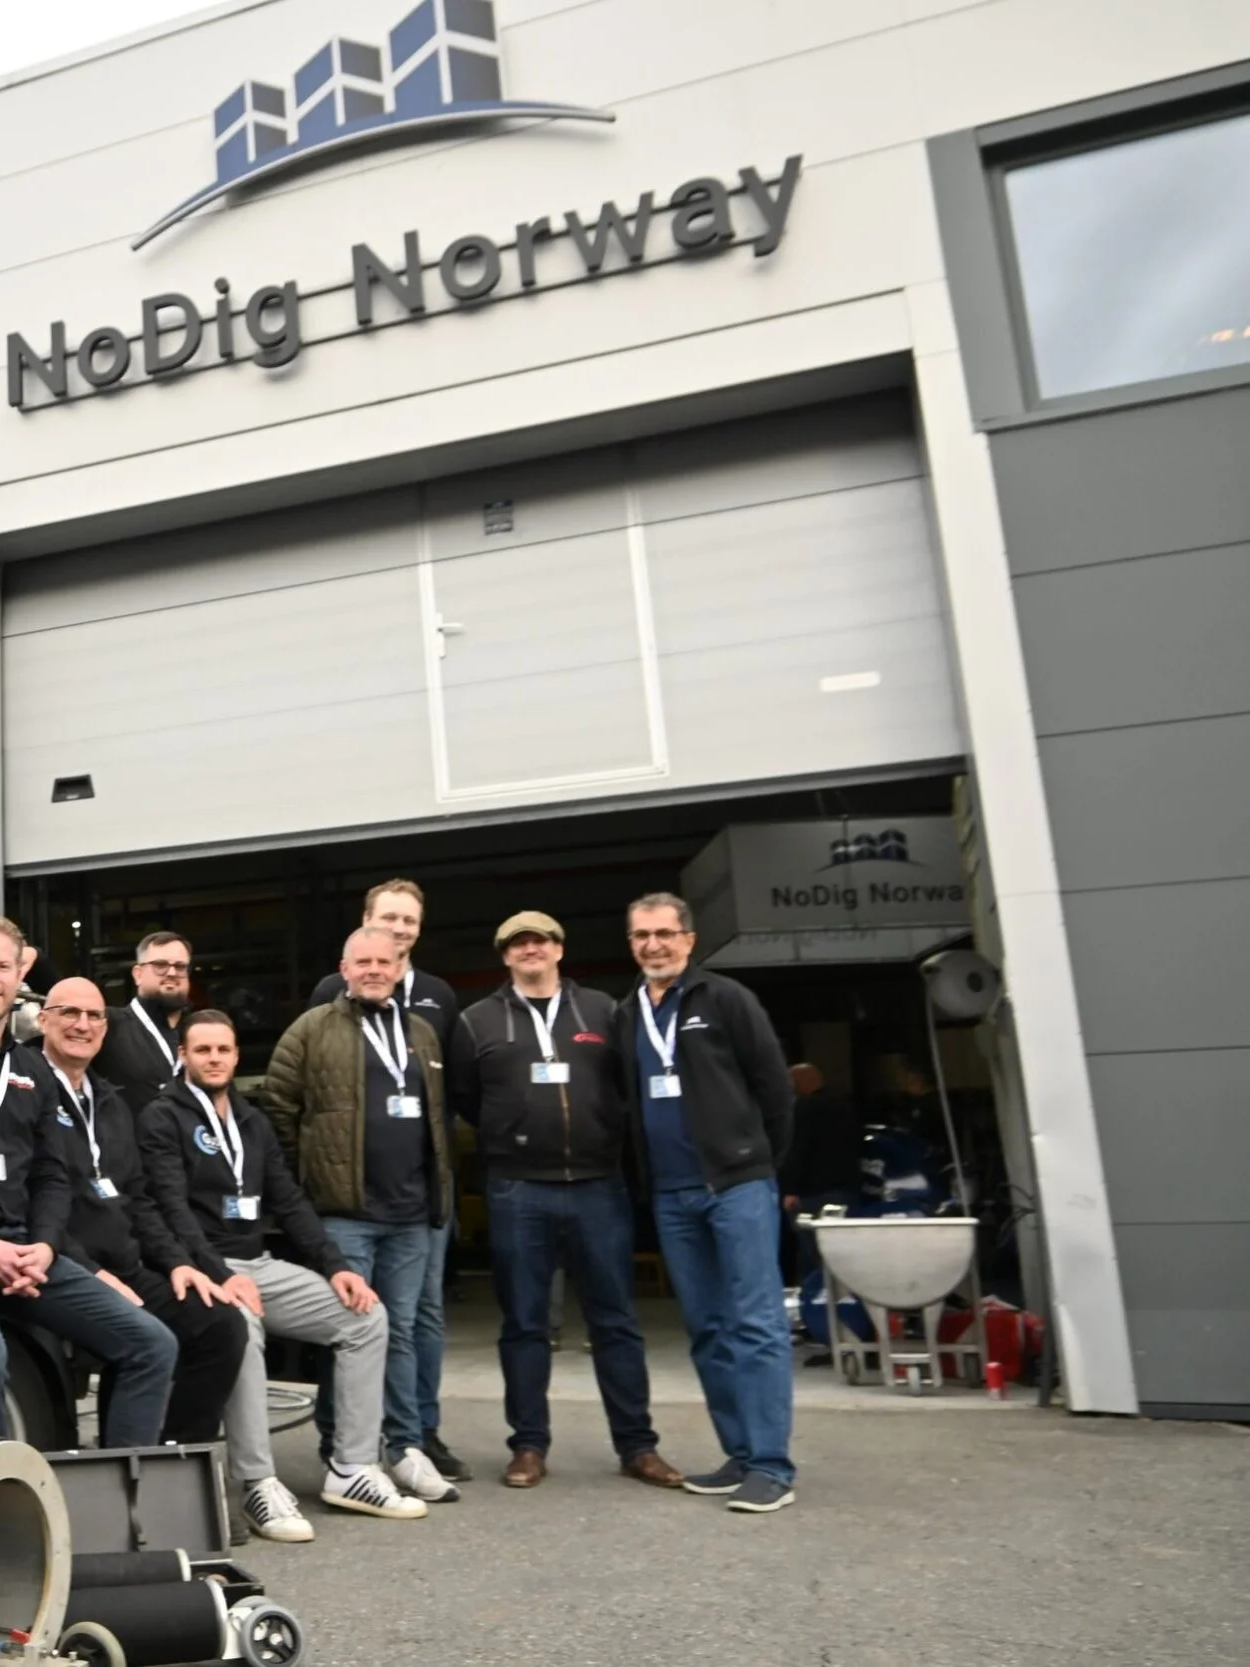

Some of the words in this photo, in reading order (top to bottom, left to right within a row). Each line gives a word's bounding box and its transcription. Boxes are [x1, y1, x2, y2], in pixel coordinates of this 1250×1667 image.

[6, 277, 301, 407] NoDig
[351, 154, 803, 325] Norway
[770, 884, 859, 911] NoDig
[868, 881, 964, 904] Norwa
